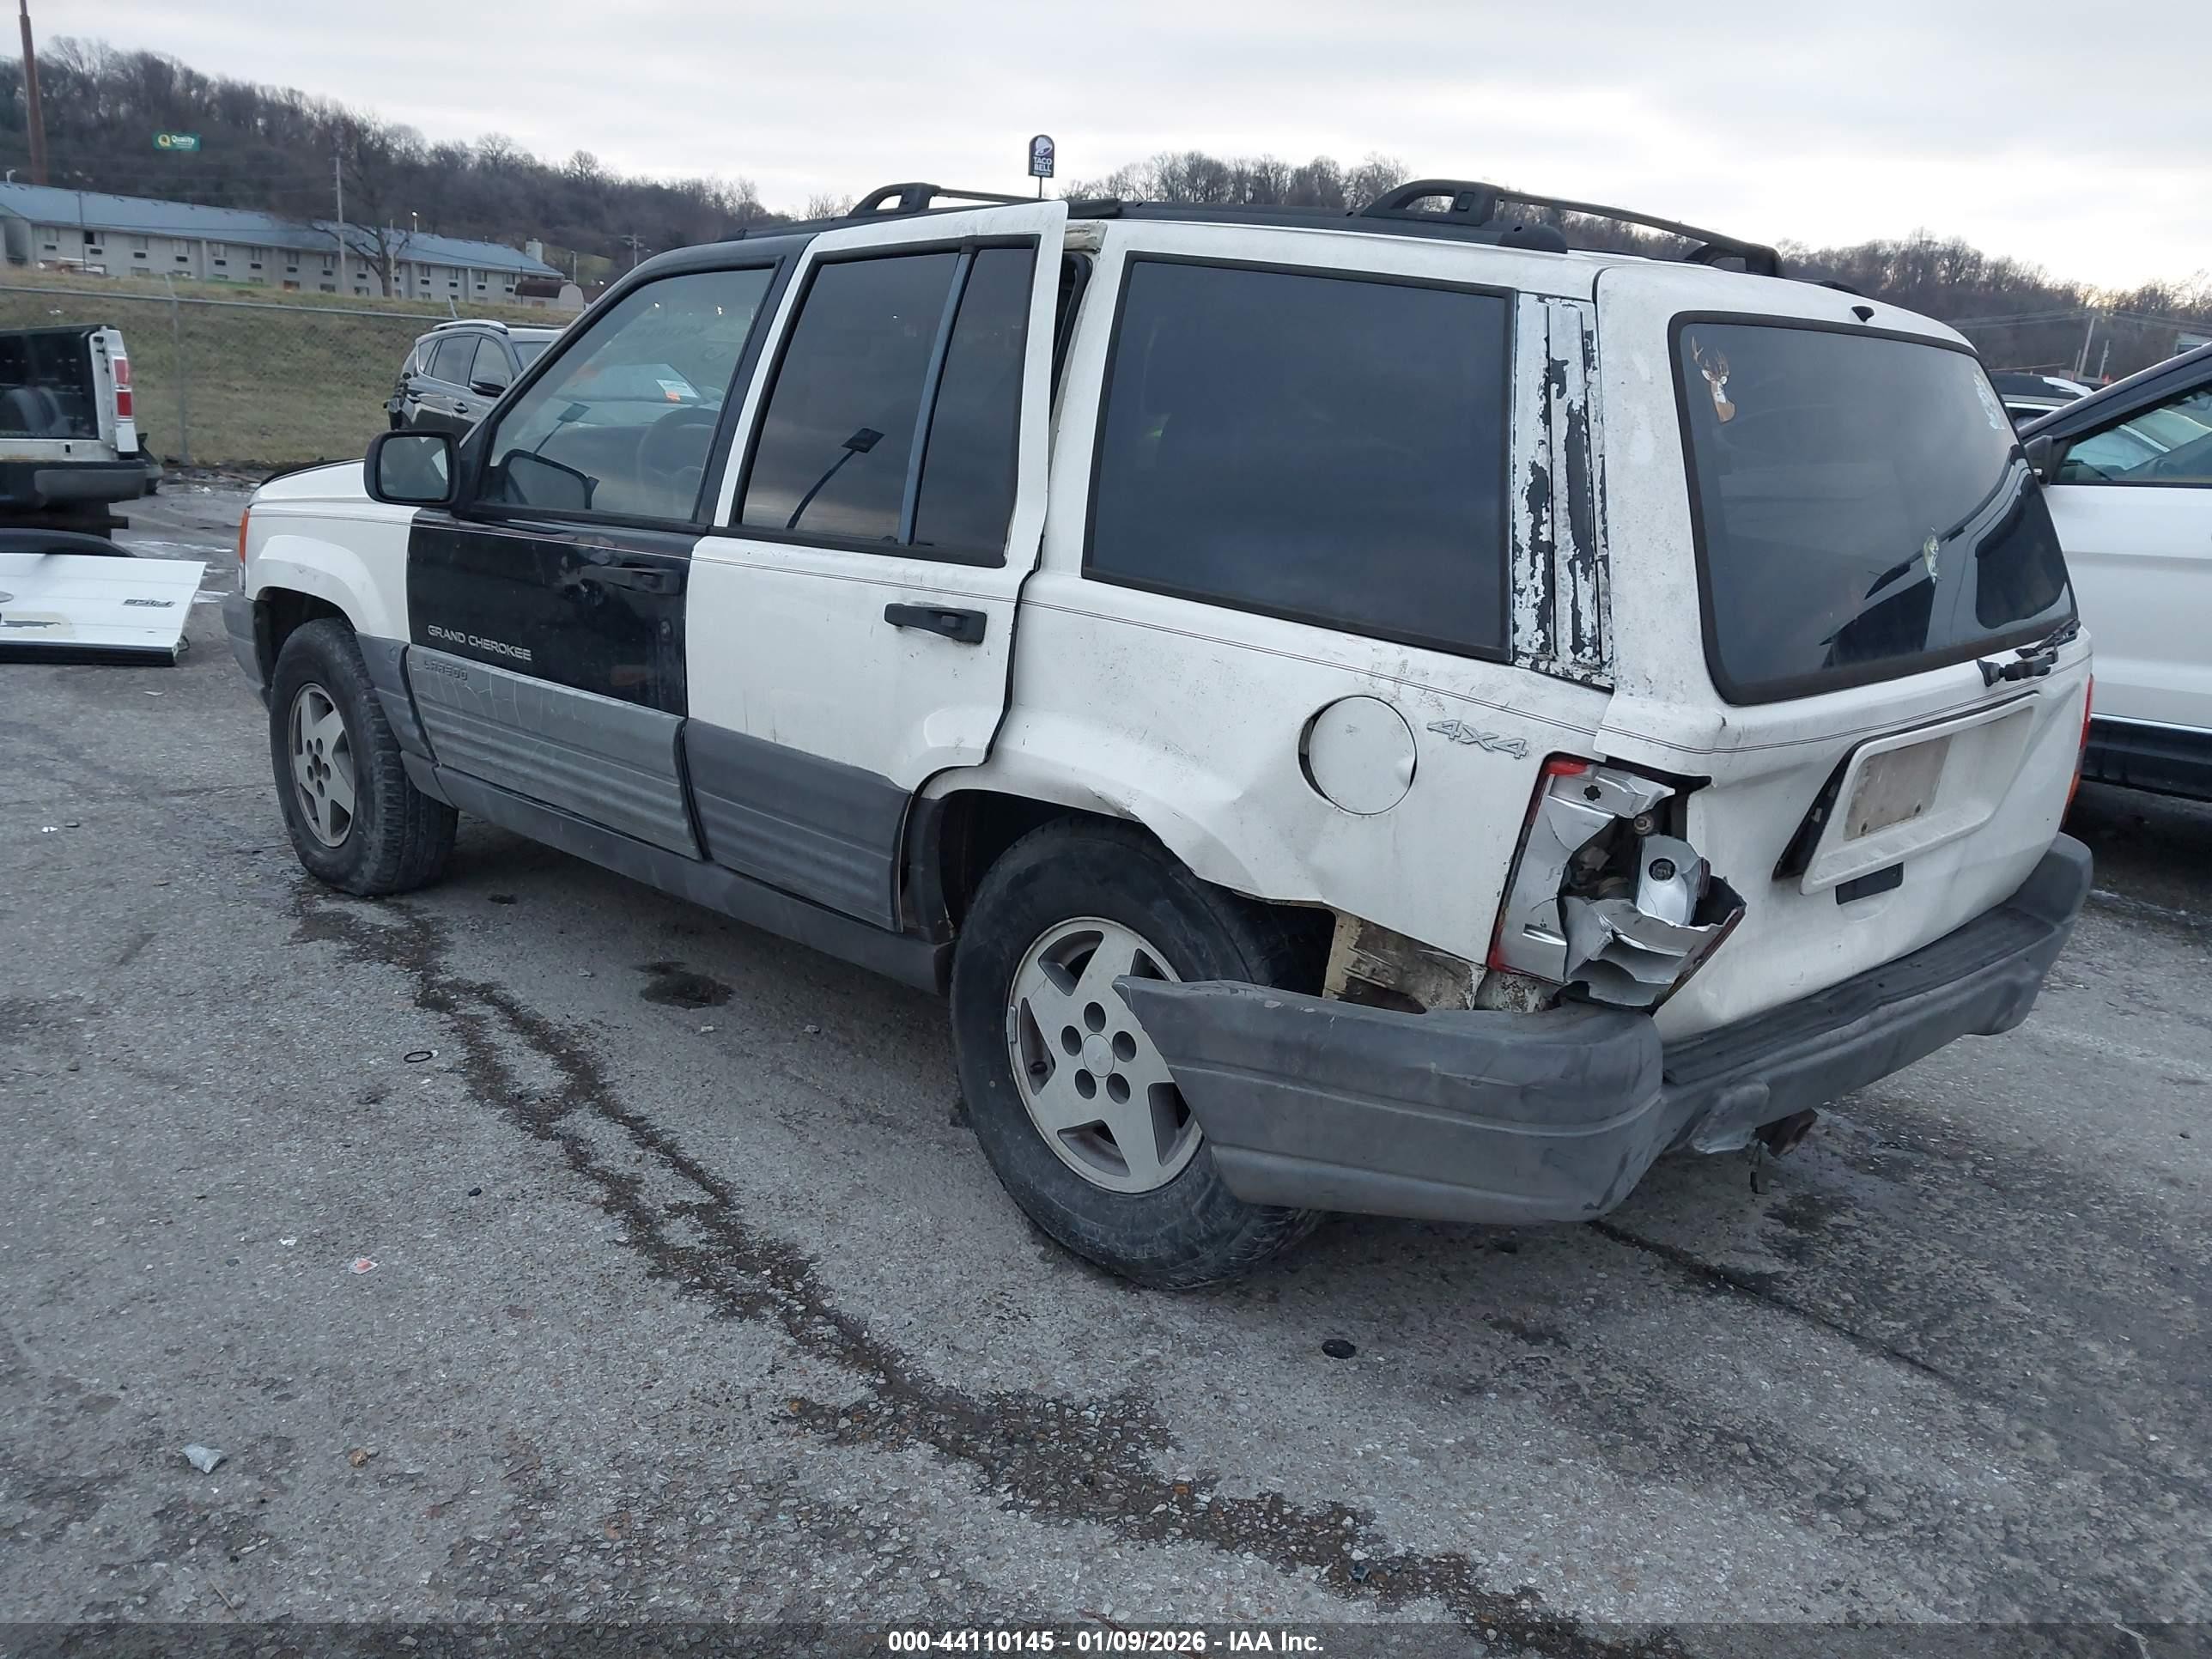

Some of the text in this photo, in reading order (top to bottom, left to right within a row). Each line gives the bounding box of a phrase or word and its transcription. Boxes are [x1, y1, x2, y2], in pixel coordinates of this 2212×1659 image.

[1033, 156, 1053, 165] TACO
[1034, 163, 1052, 172] BELL
[428, 624, 532, 661] GRAND CHEROKEE
